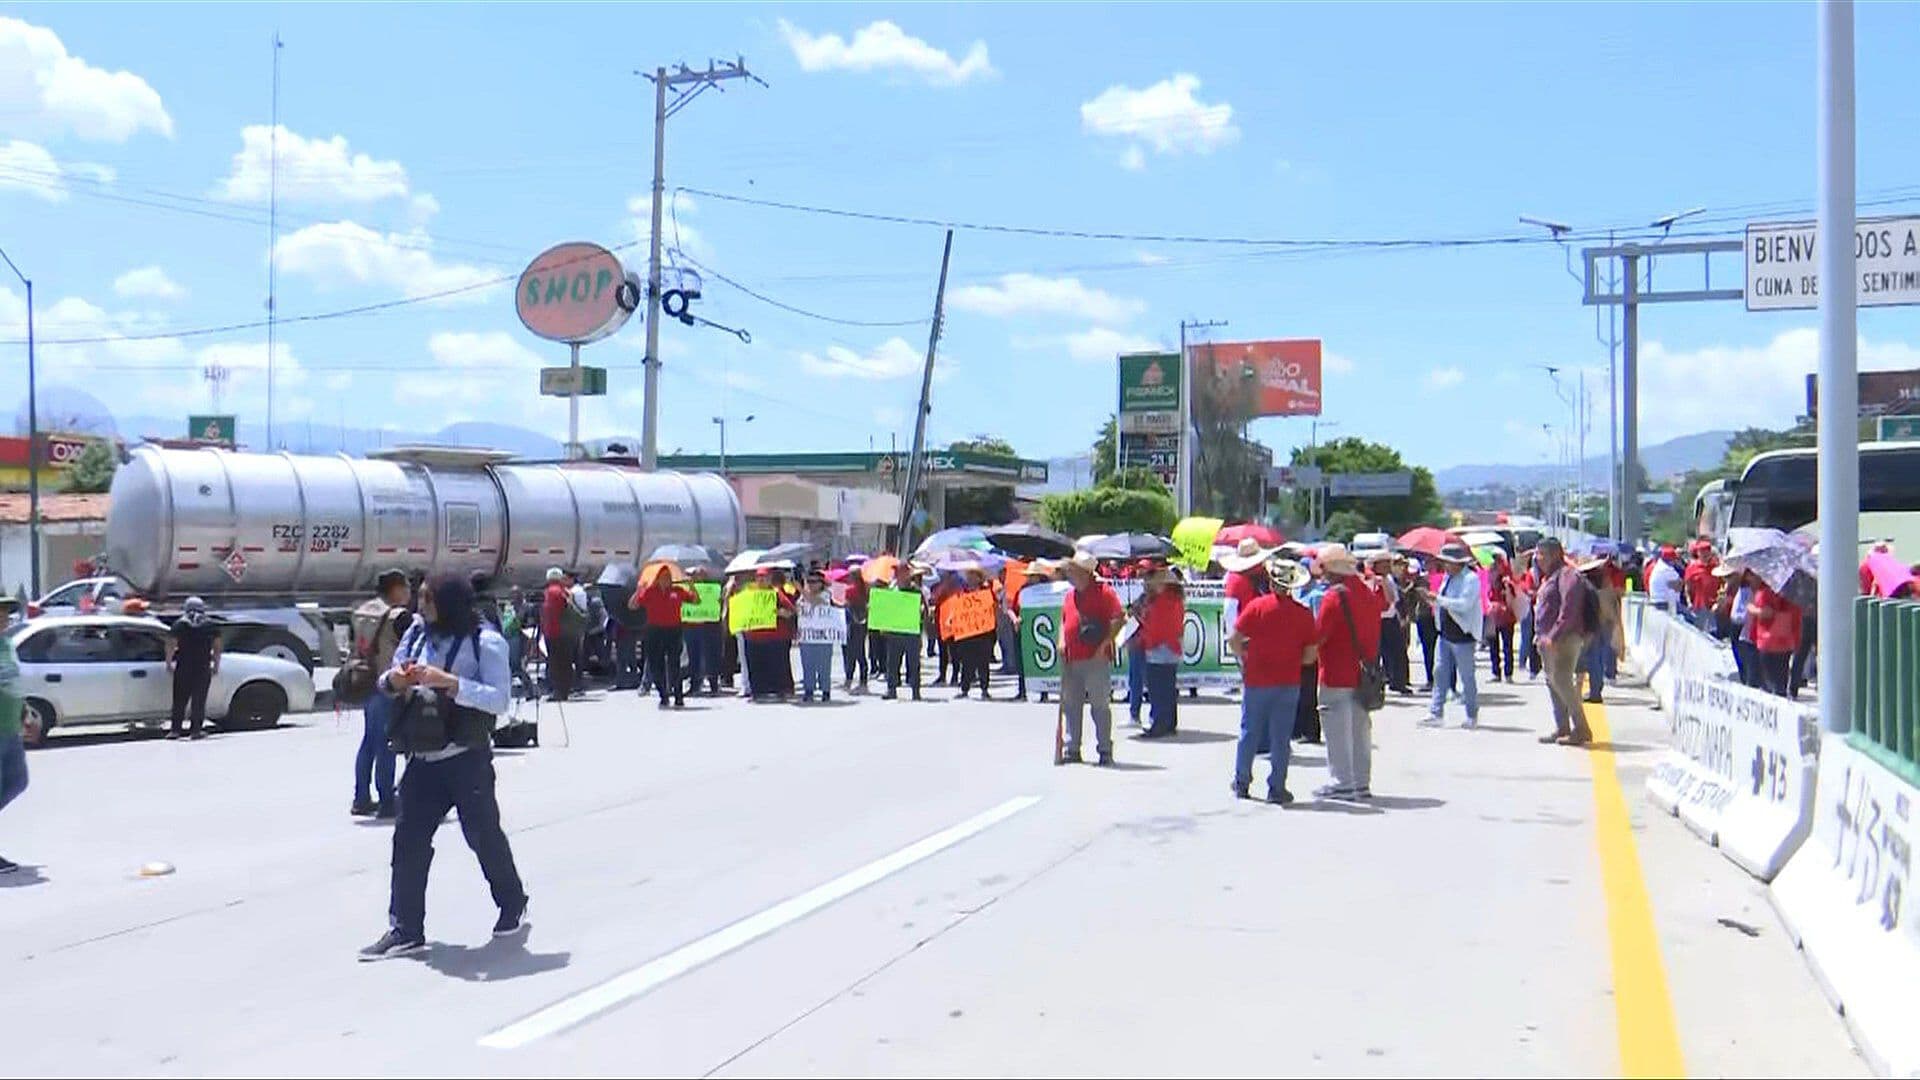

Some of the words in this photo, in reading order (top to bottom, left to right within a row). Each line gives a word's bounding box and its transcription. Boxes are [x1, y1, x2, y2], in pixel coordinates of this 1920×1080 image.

[1755, 229, 1892, 264] BIENVDOS
[1903, 229, 1917, 256] A
[526, 269, 612, 306] SHOP
[1755, 276, 1793, 297] CUNA
[1801, 275, 1819, 296] DE
[273, 525, 303, 539] FZC
